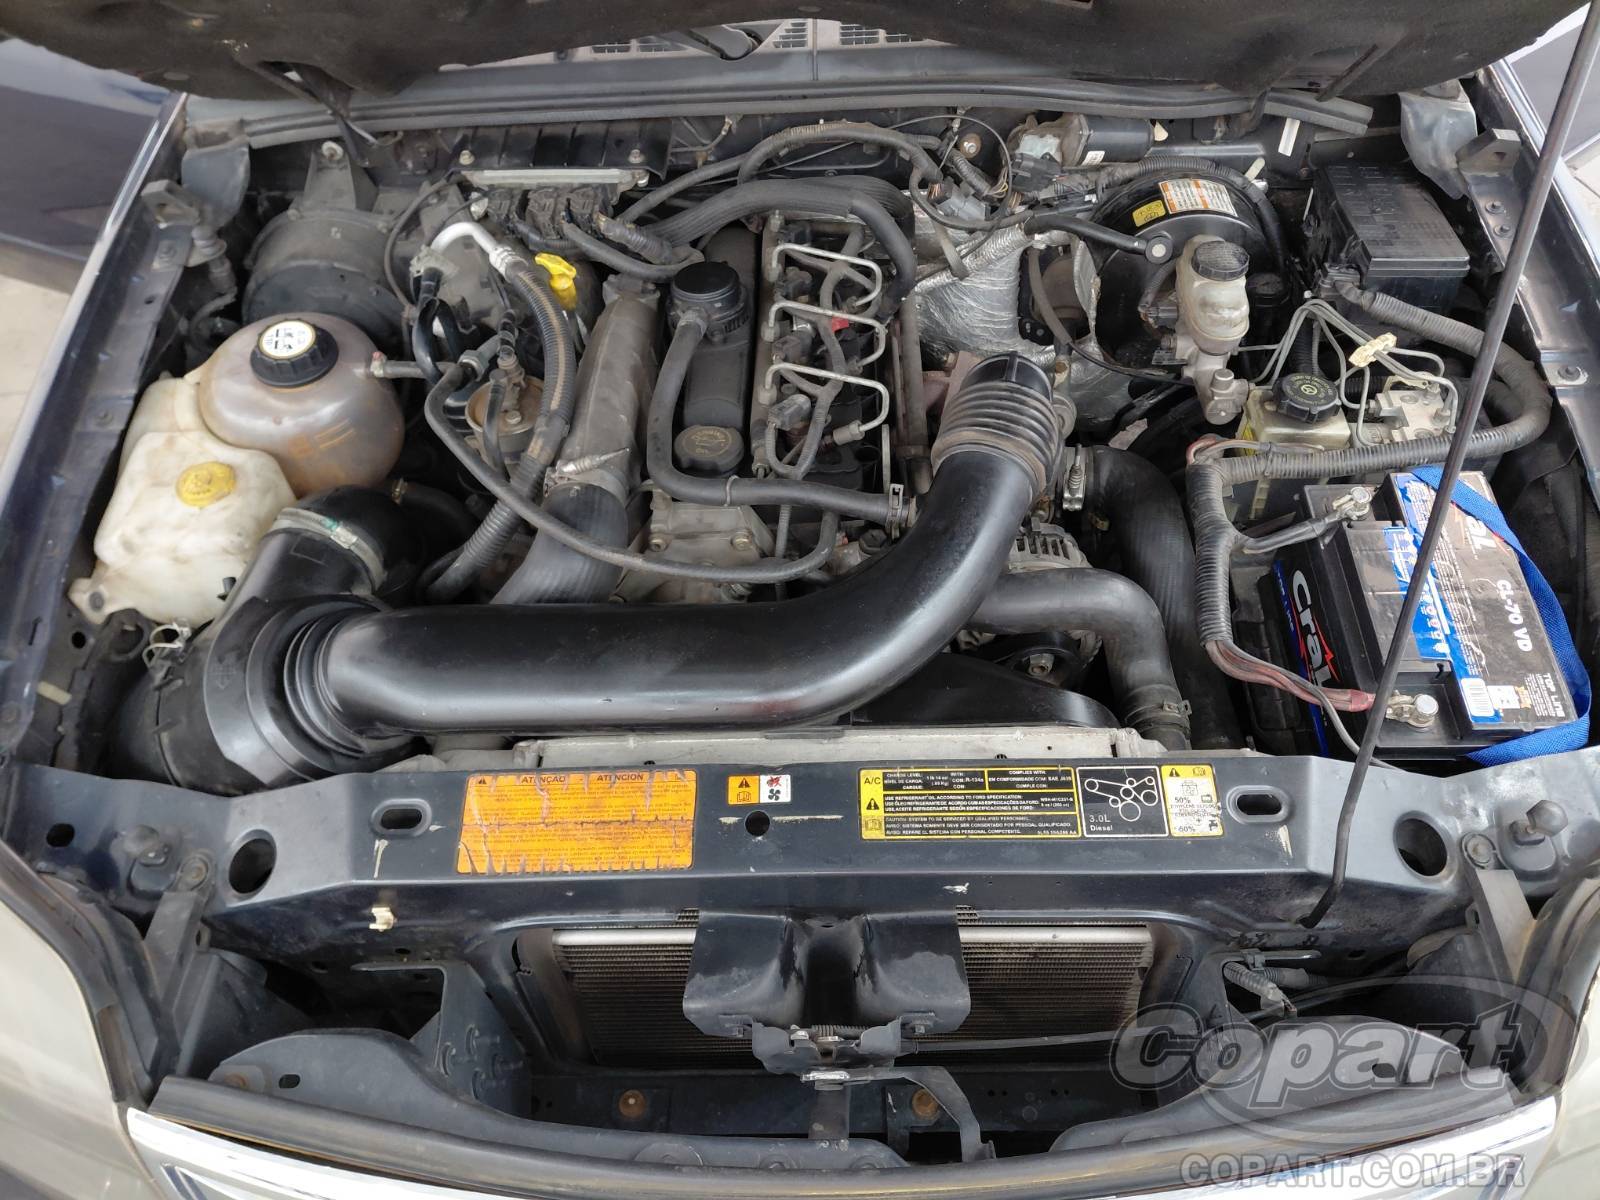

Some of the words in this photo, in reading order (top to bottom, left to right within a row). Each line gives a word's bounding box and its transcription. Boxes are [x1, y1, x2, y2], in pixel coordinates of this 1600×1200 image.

[1464, 515, 1496, 551] aL
[1496, 578, 1524, 627] CL-70
[1512, 625, 1534, 653] VD
[1543, 673, 1556, 692] TOP
[864, 777, 881, 785] A/C
[1089, 815, 1111, 823] 3.0L
